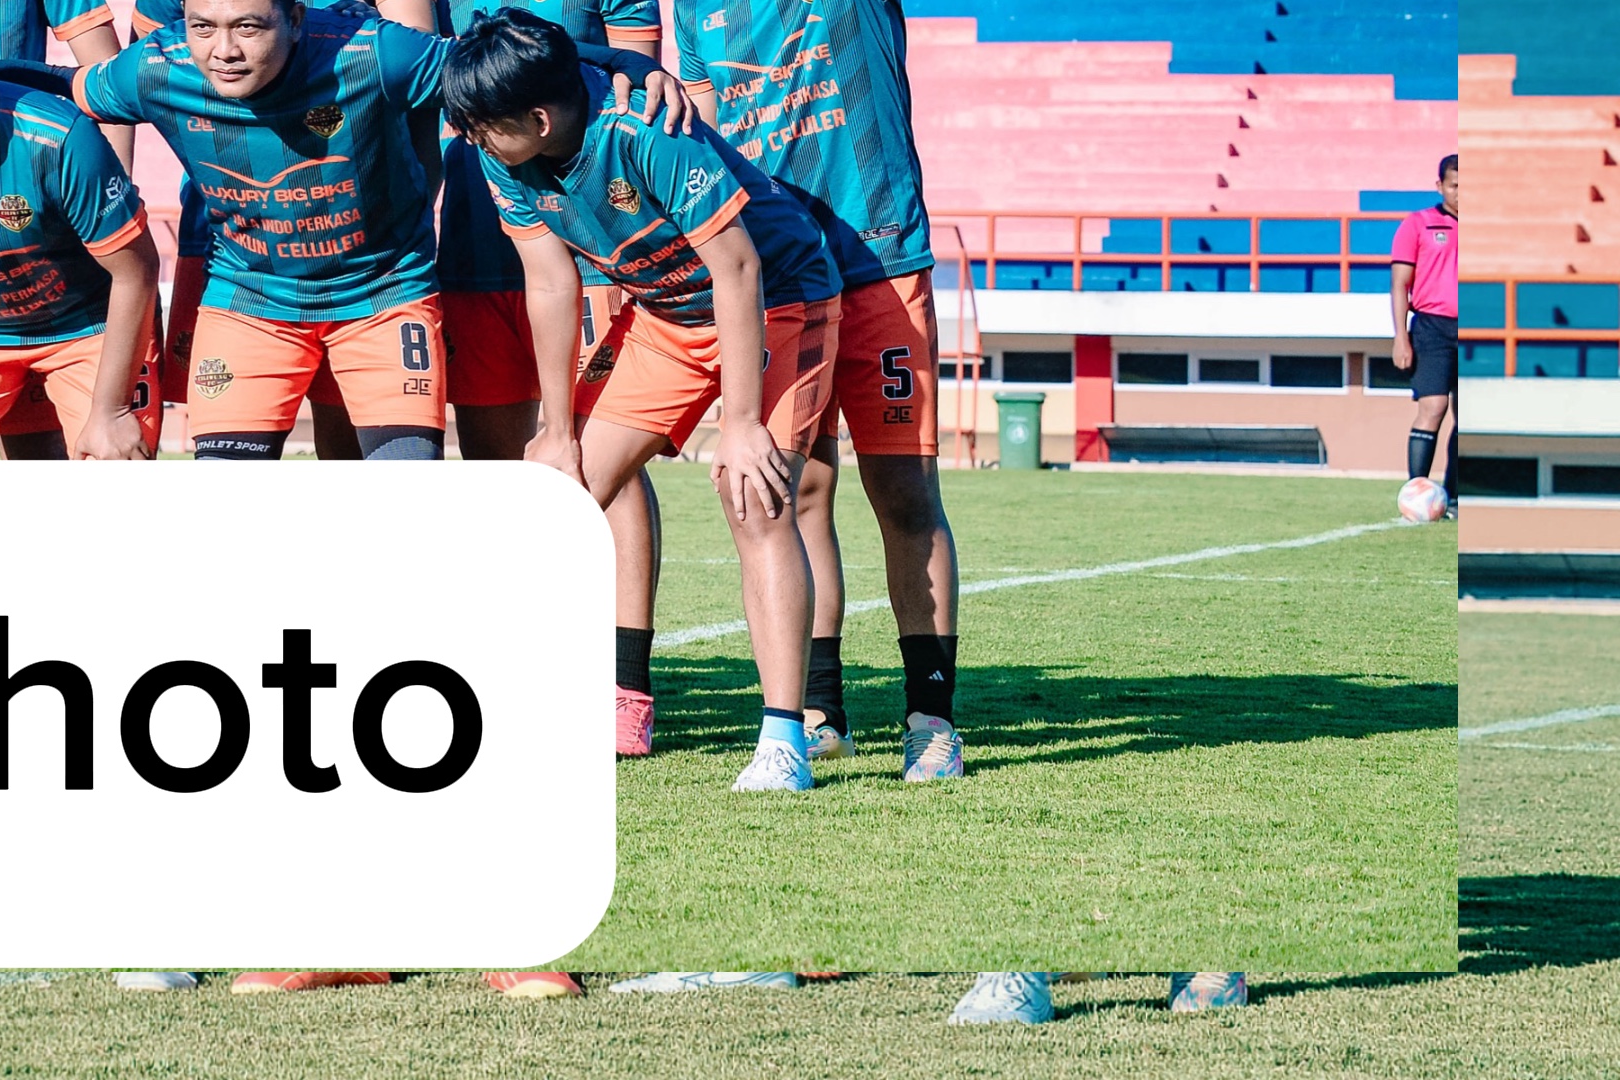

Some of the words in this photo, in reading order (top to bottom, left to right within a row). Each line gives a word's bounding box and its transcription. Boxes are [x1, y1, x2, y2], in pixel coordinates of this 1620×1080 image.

[200, 183, 270, 203] LUXURY
[274, 188, 308, 202] BIG
[311, 179, 355, 199] BIKE
[261, 218, 294, 234] INDO
[296, 208, 362, 233] PERKASA
[276, 230, 366, 259] CELLULER
[617, 258, 652, 275] BIG
[0, 269, 60, 304] PERKASA
[398, 321, 432, 373] 8
[879, 345, 914, 401] 5
[234, 441, 271, 453] SPORT
